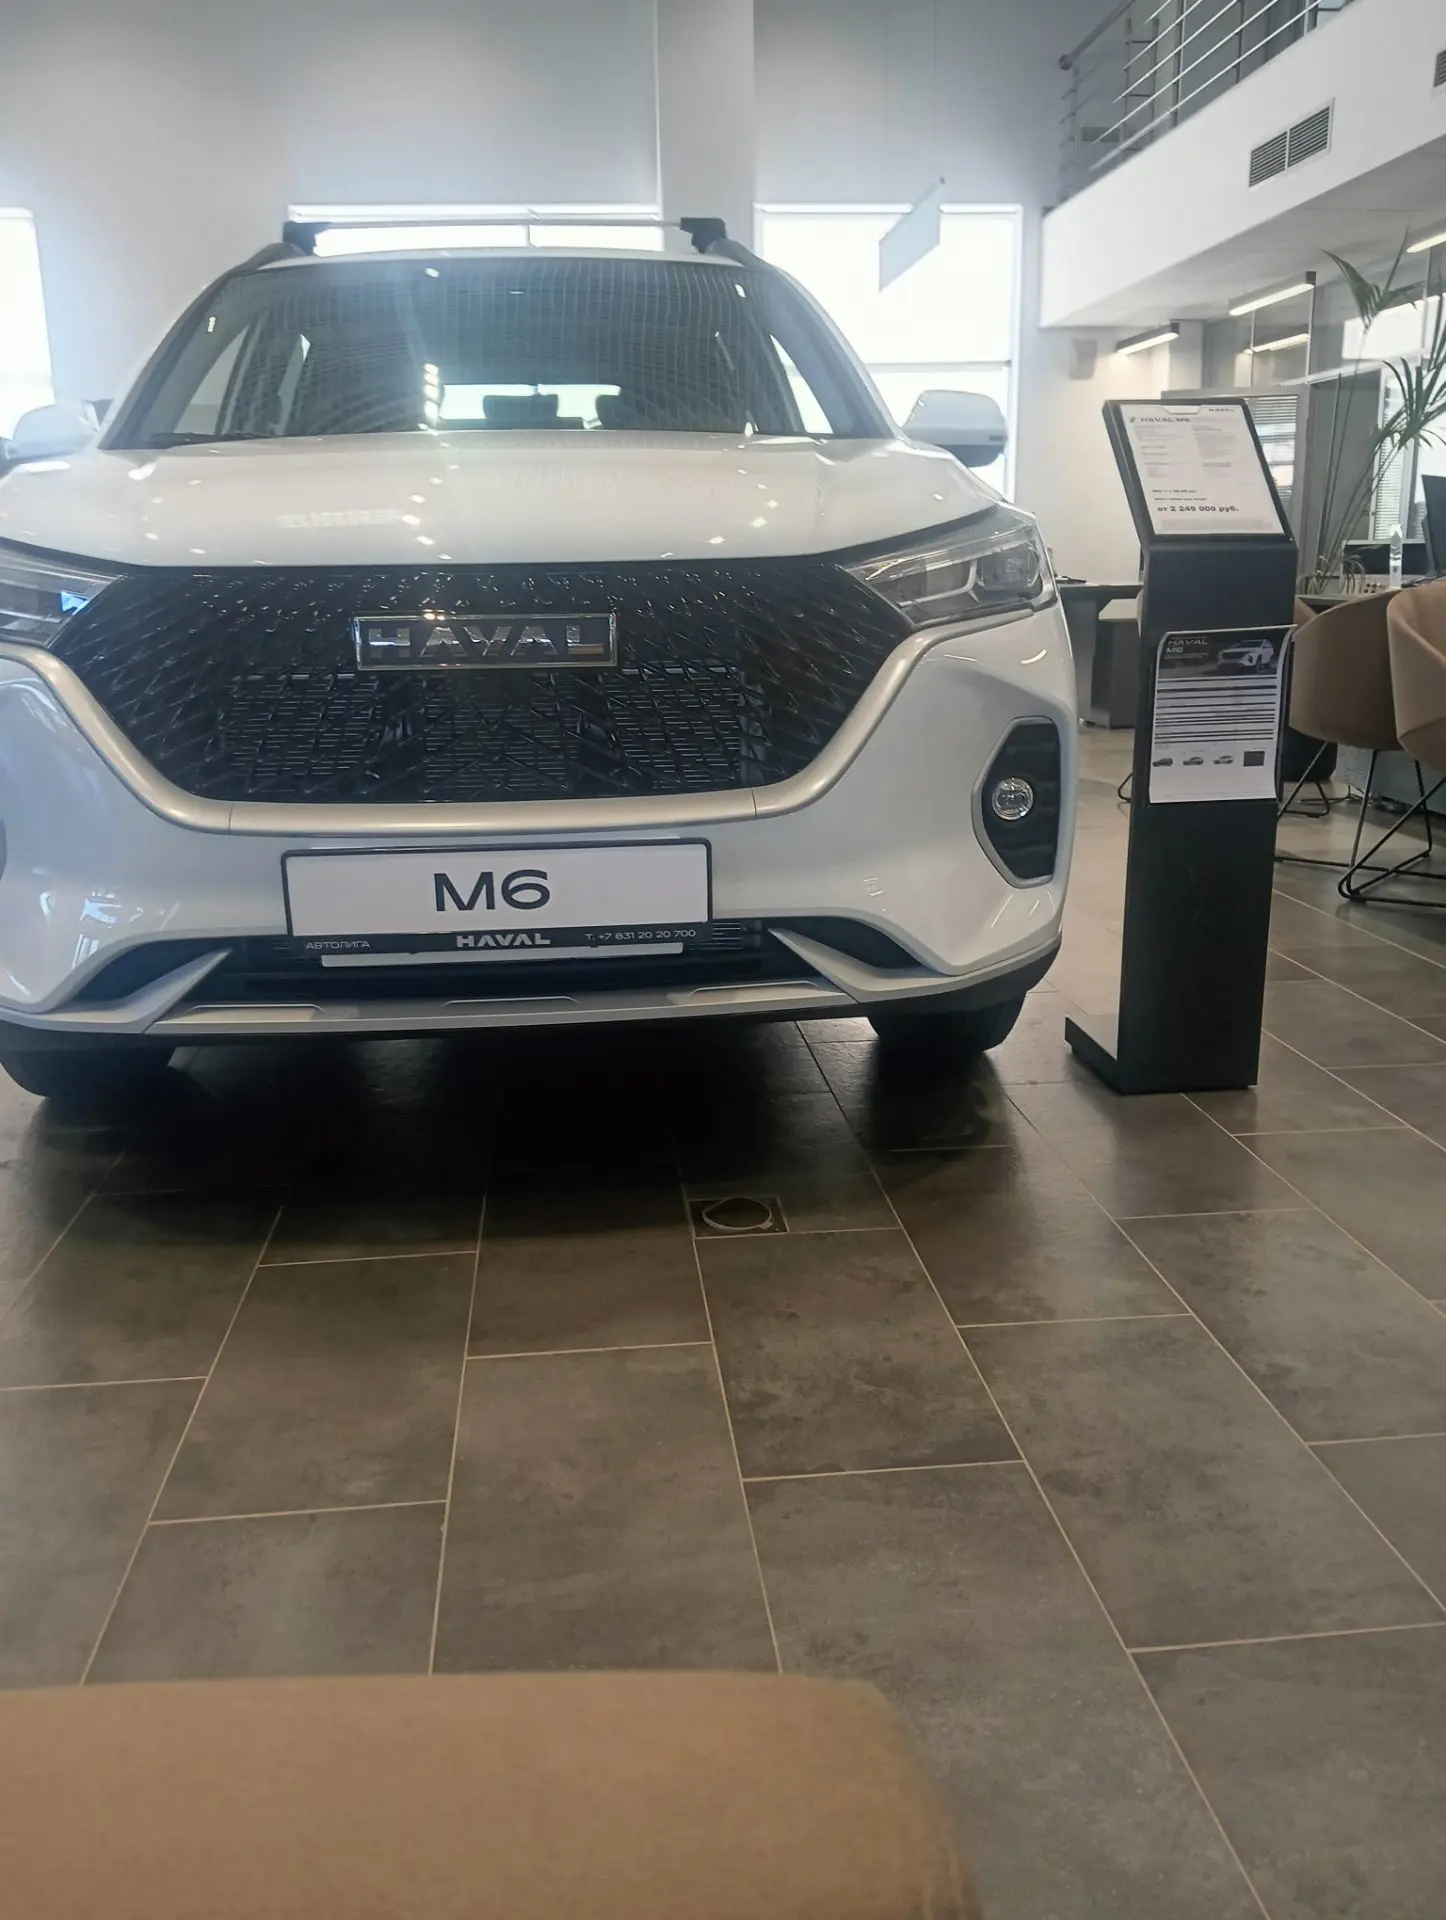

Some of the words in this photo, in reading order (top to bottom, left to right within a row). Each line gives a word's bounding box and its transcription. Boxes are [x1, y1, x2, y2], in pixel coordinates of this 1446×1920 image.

[368, 625, 604, 658] HAVAL
[1167, 638, 1208, 646] HAVAL
[434, 869, 550, 912] M6
[456, 933, 551, 948] HAVAL
[598, 932, 612, 940] +7
[615, 931, 635, 940] 831
[637, 931, 653, 939] 20
[655, 930, 671, 938] 20
[674, 929, 696, 938] 700
[306, 940, 371, 950] АВТОЛИГА
